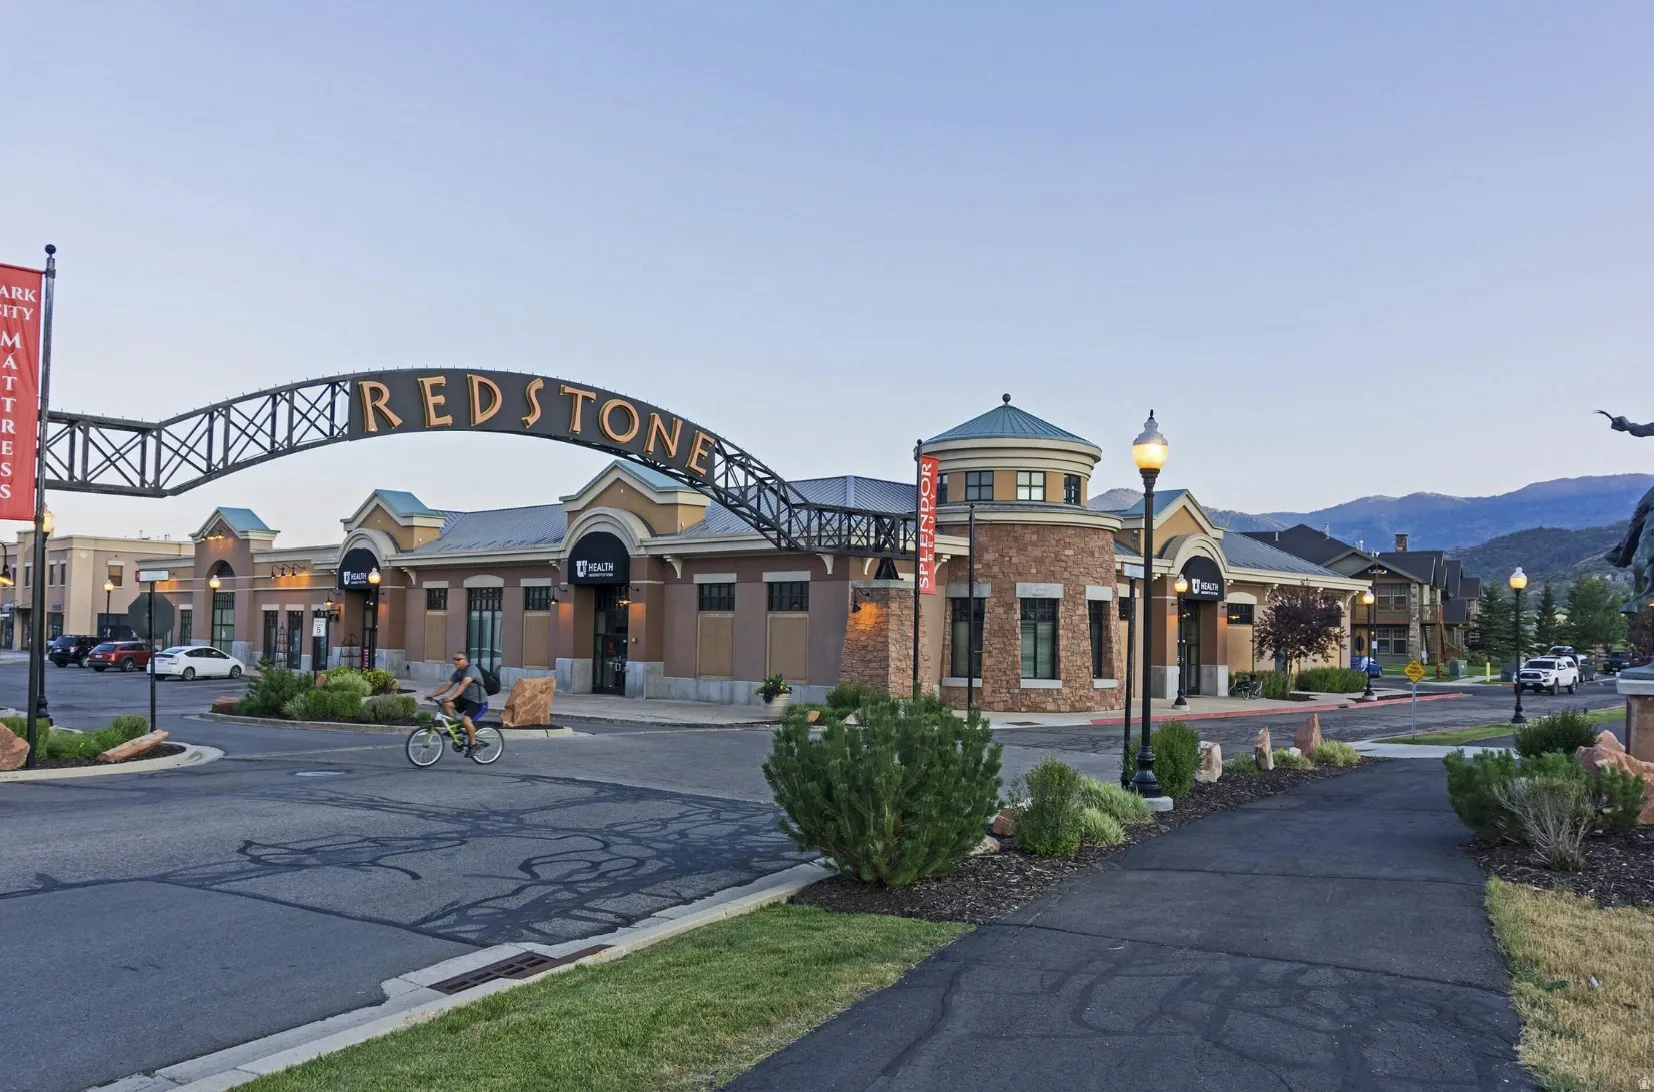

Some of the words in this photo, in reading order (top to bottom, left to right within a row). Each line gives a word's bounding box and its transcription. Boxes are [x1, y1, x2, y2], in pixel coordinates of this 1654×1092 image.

[0, 304, 35, 321] ITY
[0, 332, 22, 499] MATTRESS
[358, 373, 716, 477] REDSTONE
[919, 462, 932, 589] SPLENDOR
[928, 493, 936, 561] BEAUTY
[588, 562, 613, 572] HEALTH
[1200, 582, 1219, 591] HEALTH
